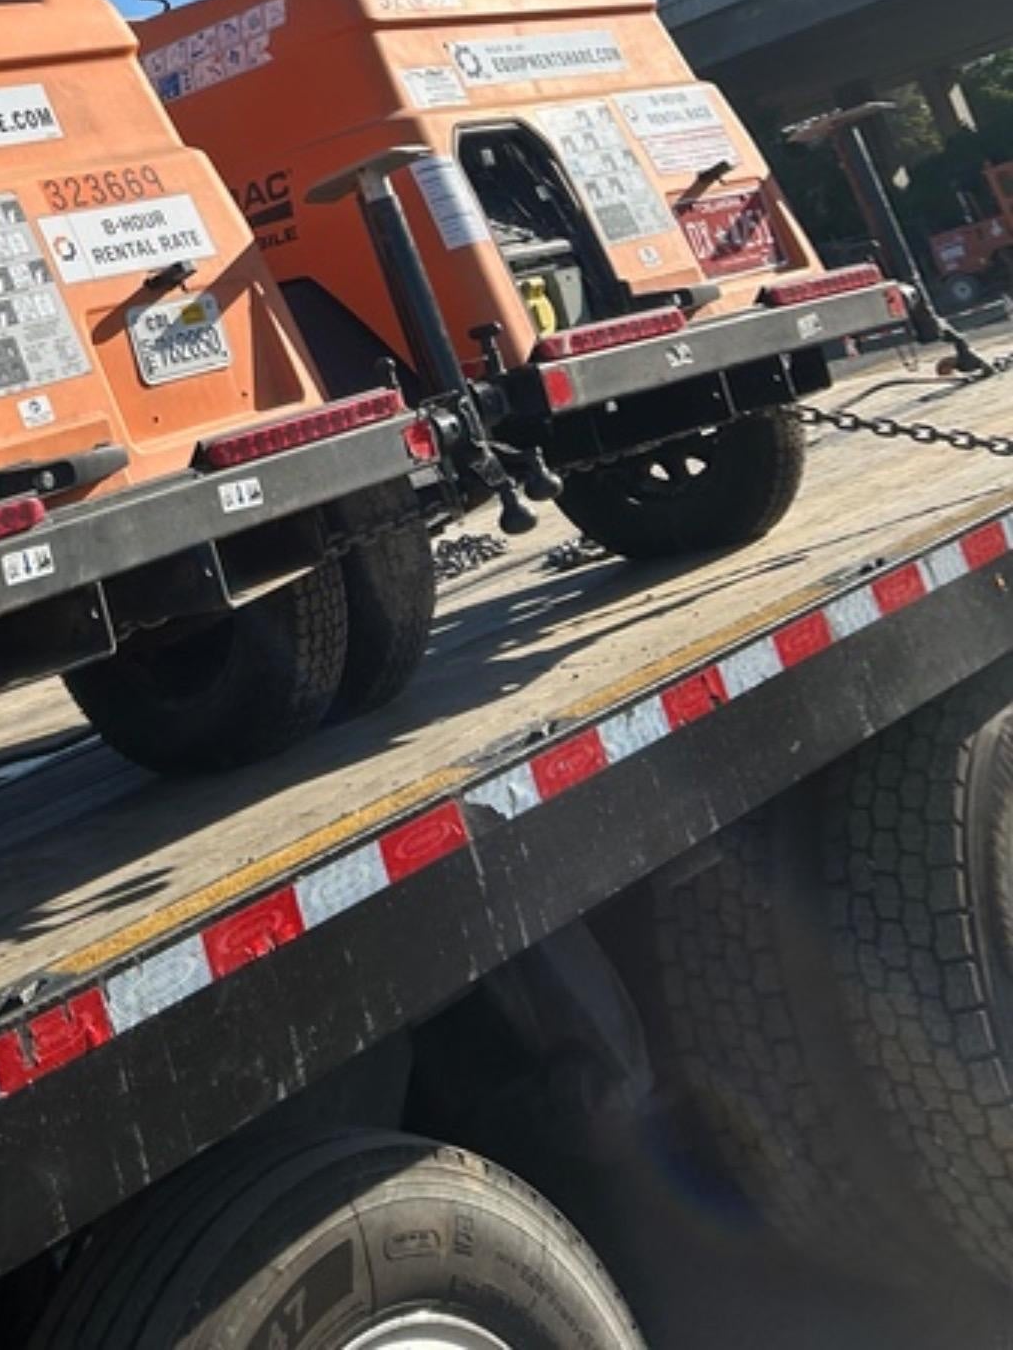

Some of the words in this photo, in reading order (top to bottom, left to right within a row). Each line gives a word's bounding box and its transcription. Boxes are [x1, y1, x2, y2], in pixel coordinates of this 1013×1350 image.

[43, 163, 166, 212] 323669
[100, 209, 168, 236] 8-HOUR
[91, 238, 159, 265] RENTAL
[158, 229, 203, 252] RATE
